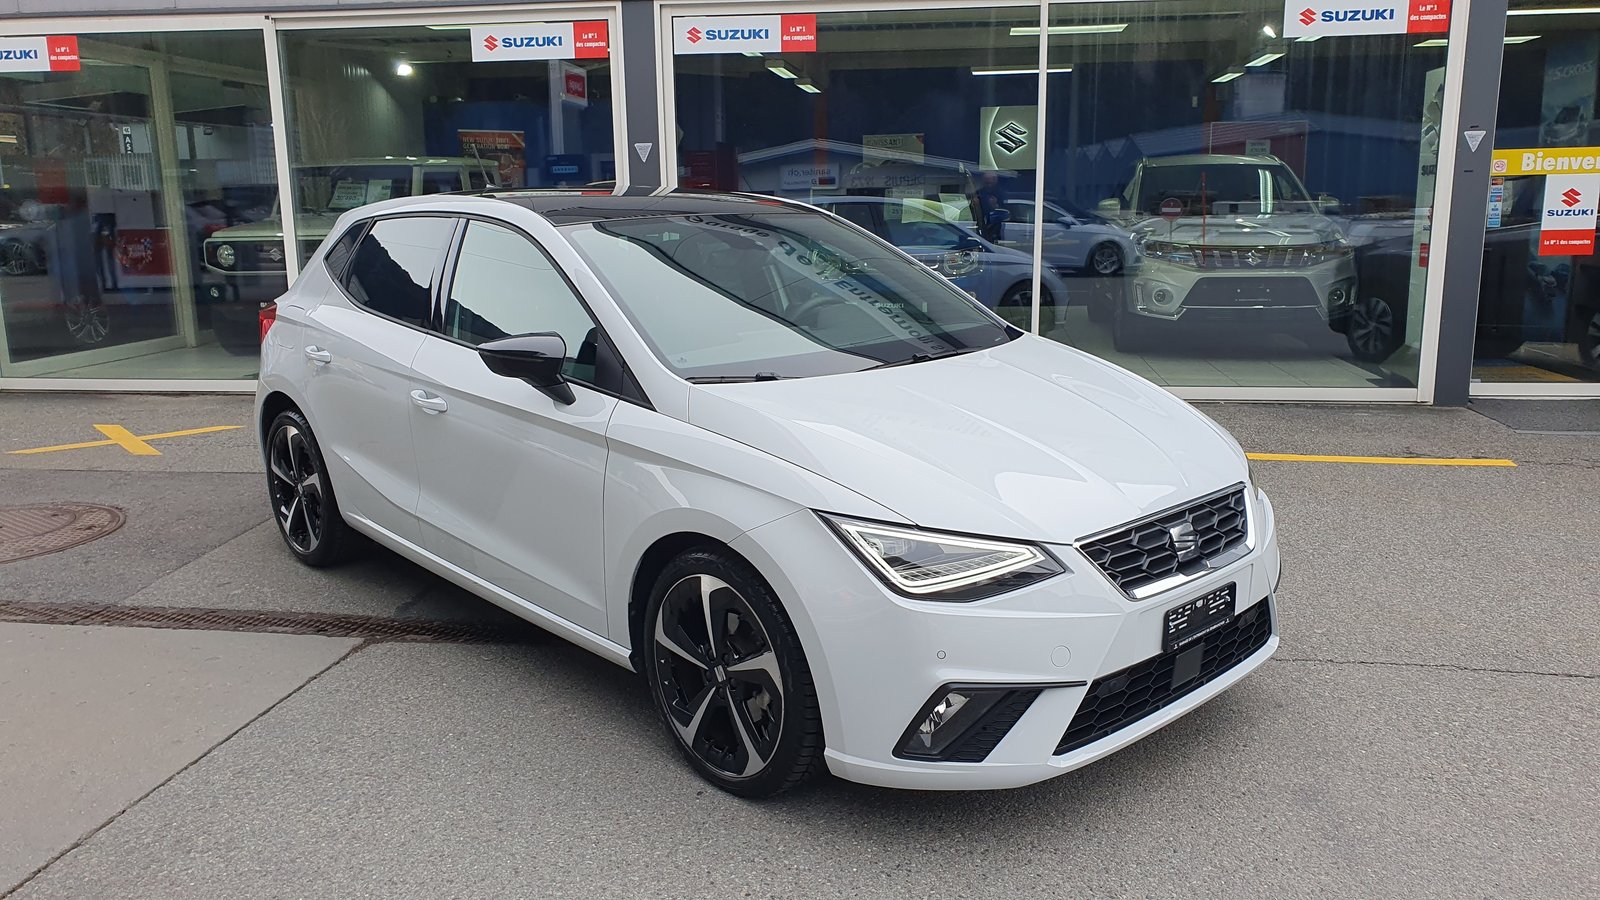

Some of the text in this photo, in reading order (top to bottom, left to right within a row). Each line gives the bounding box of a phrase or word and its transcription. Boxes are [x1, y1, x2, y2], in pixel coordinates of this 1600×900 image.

[1321, 8, 1395, 23] SUZUKI
[1420, 13, 1447, 22] compactes
[705, 28, 769, 41] SUZUKI
[501, 36, 563, 48] SUZUKI
[0, 49, 39, 60] ZUKI
[1547, 208, 1594, 217] SUZUKI
